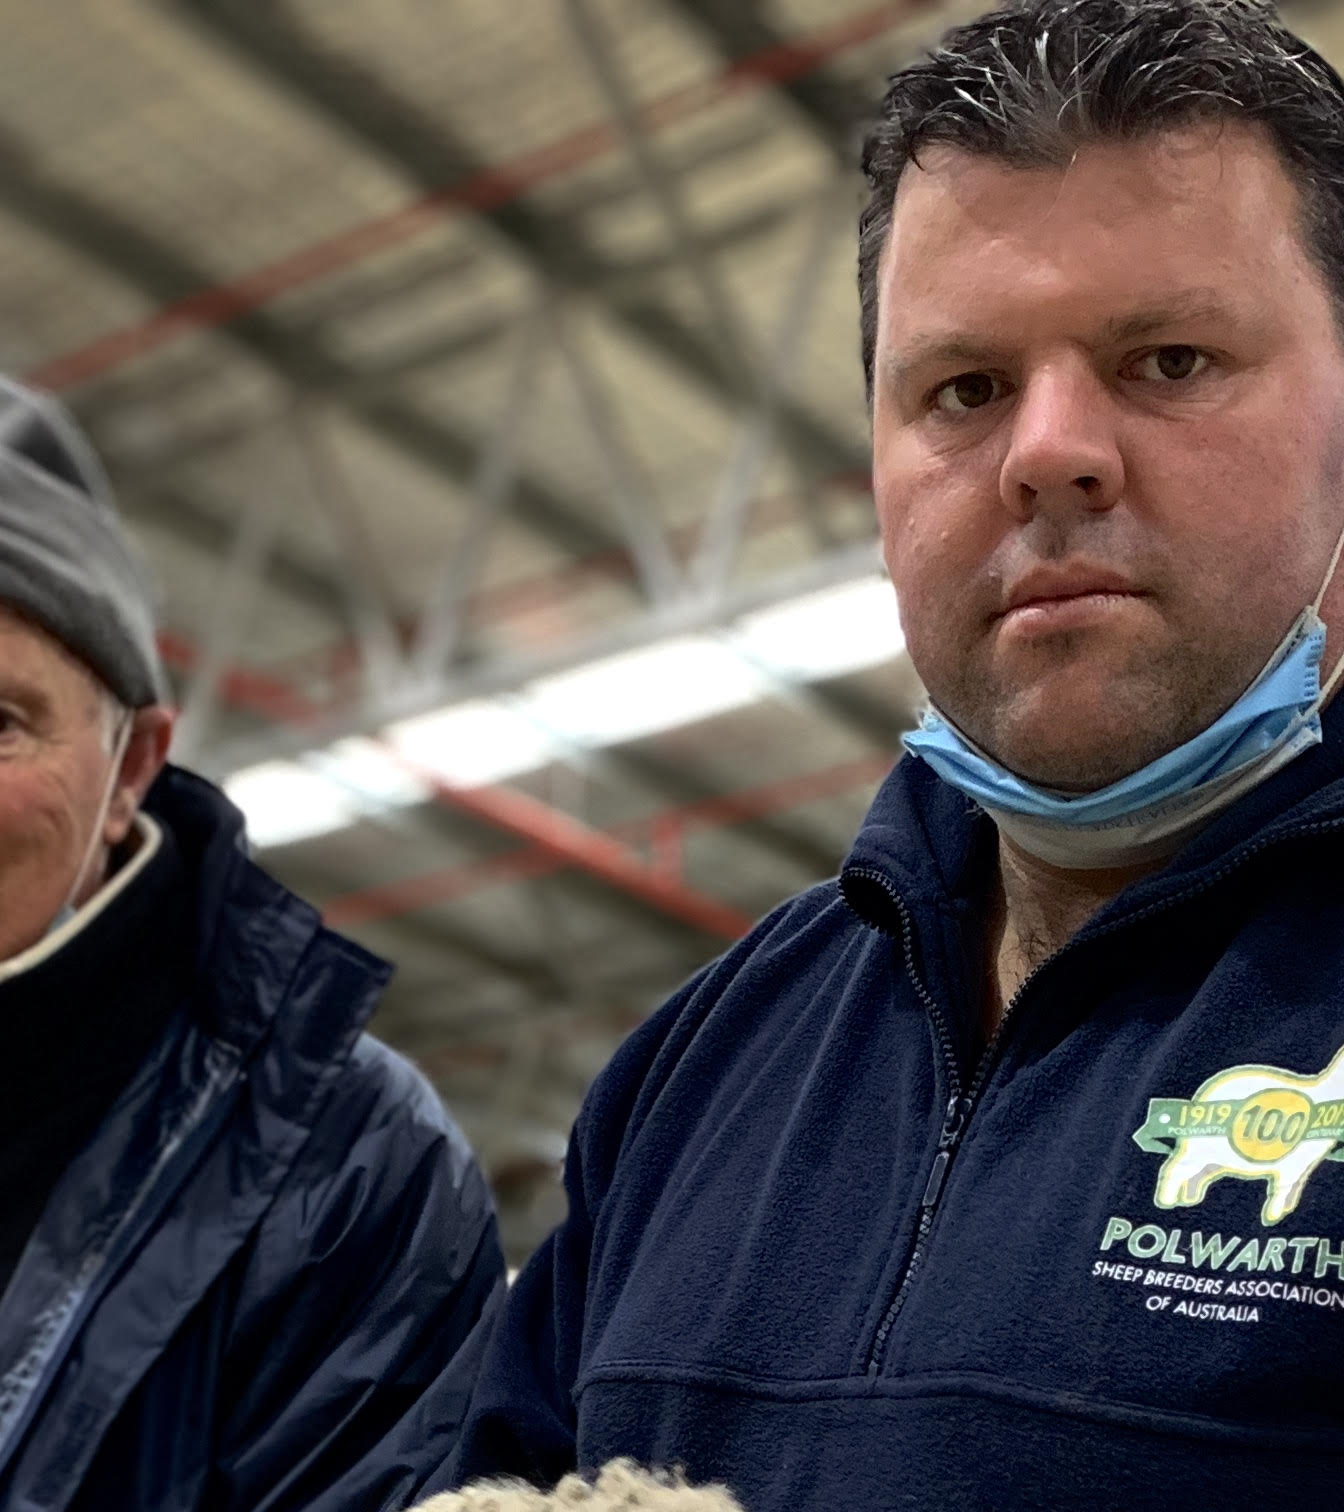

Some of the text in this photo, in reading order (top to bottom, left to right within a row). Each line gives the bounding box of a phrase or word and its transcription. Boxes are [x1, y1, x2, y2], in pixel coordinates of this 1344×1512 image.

[1179, 1105, 1231, 1127] 1919
[1242, 1105, 1306, 1144] 100
[1092, 1261, 1143, 1283] SHEEP
[1143, 1270, 1223, 1296] BREEDERS
[1145, 1295, 1260, 1322] OF AUSTRALIA
